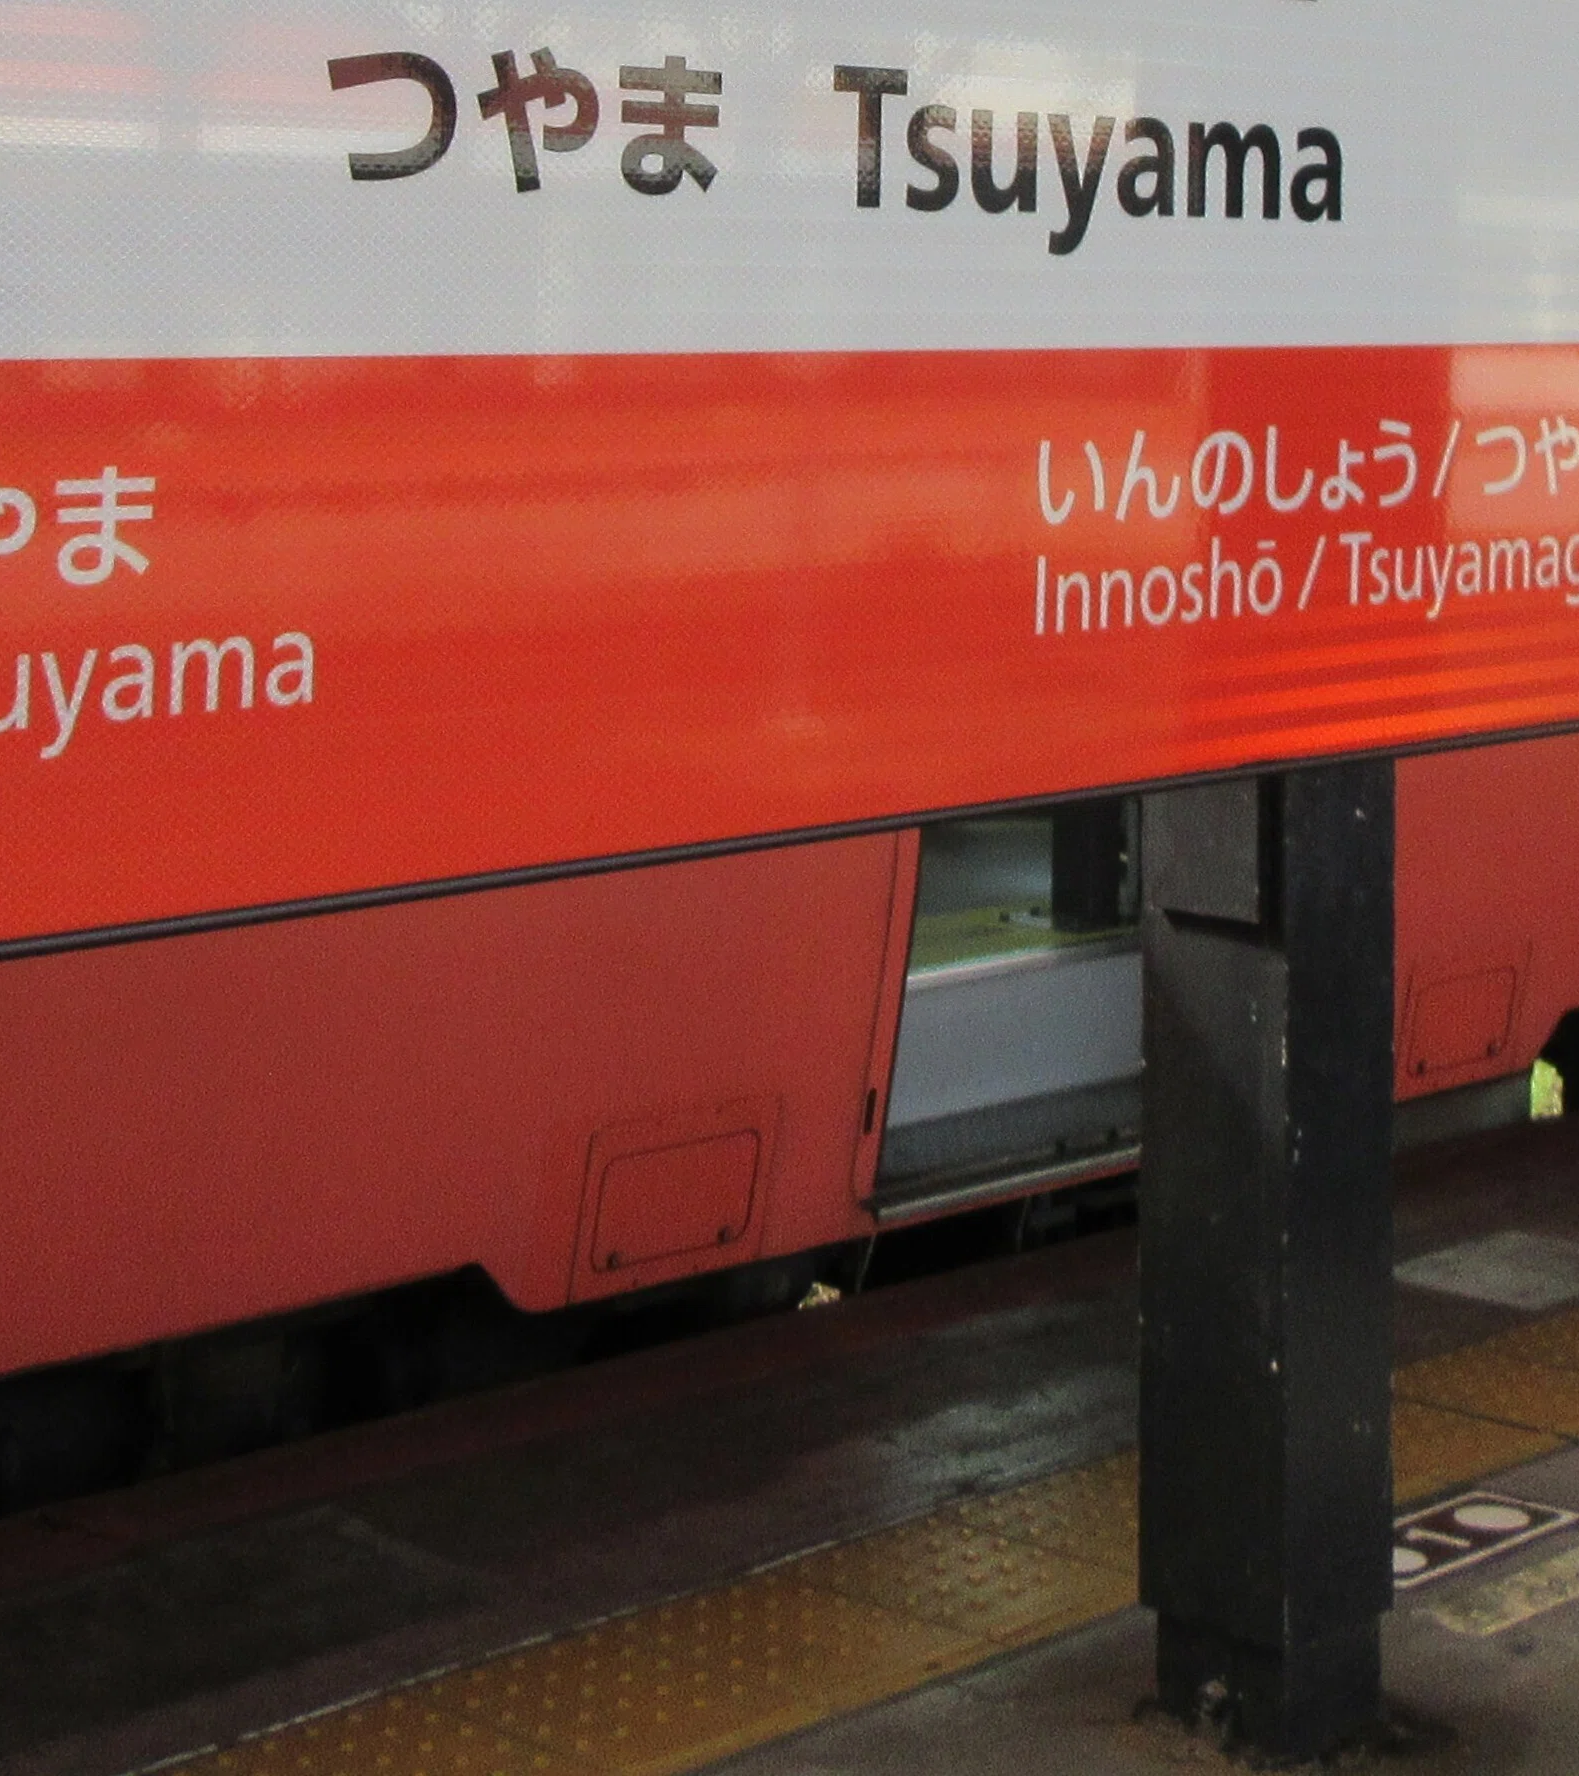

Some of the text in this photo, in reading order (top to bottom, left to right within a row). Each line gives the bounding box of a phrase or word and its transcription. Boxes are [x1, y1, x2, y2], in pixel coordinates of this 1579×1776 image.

[326, 46, 1344, 257] つやま Tsuyama
